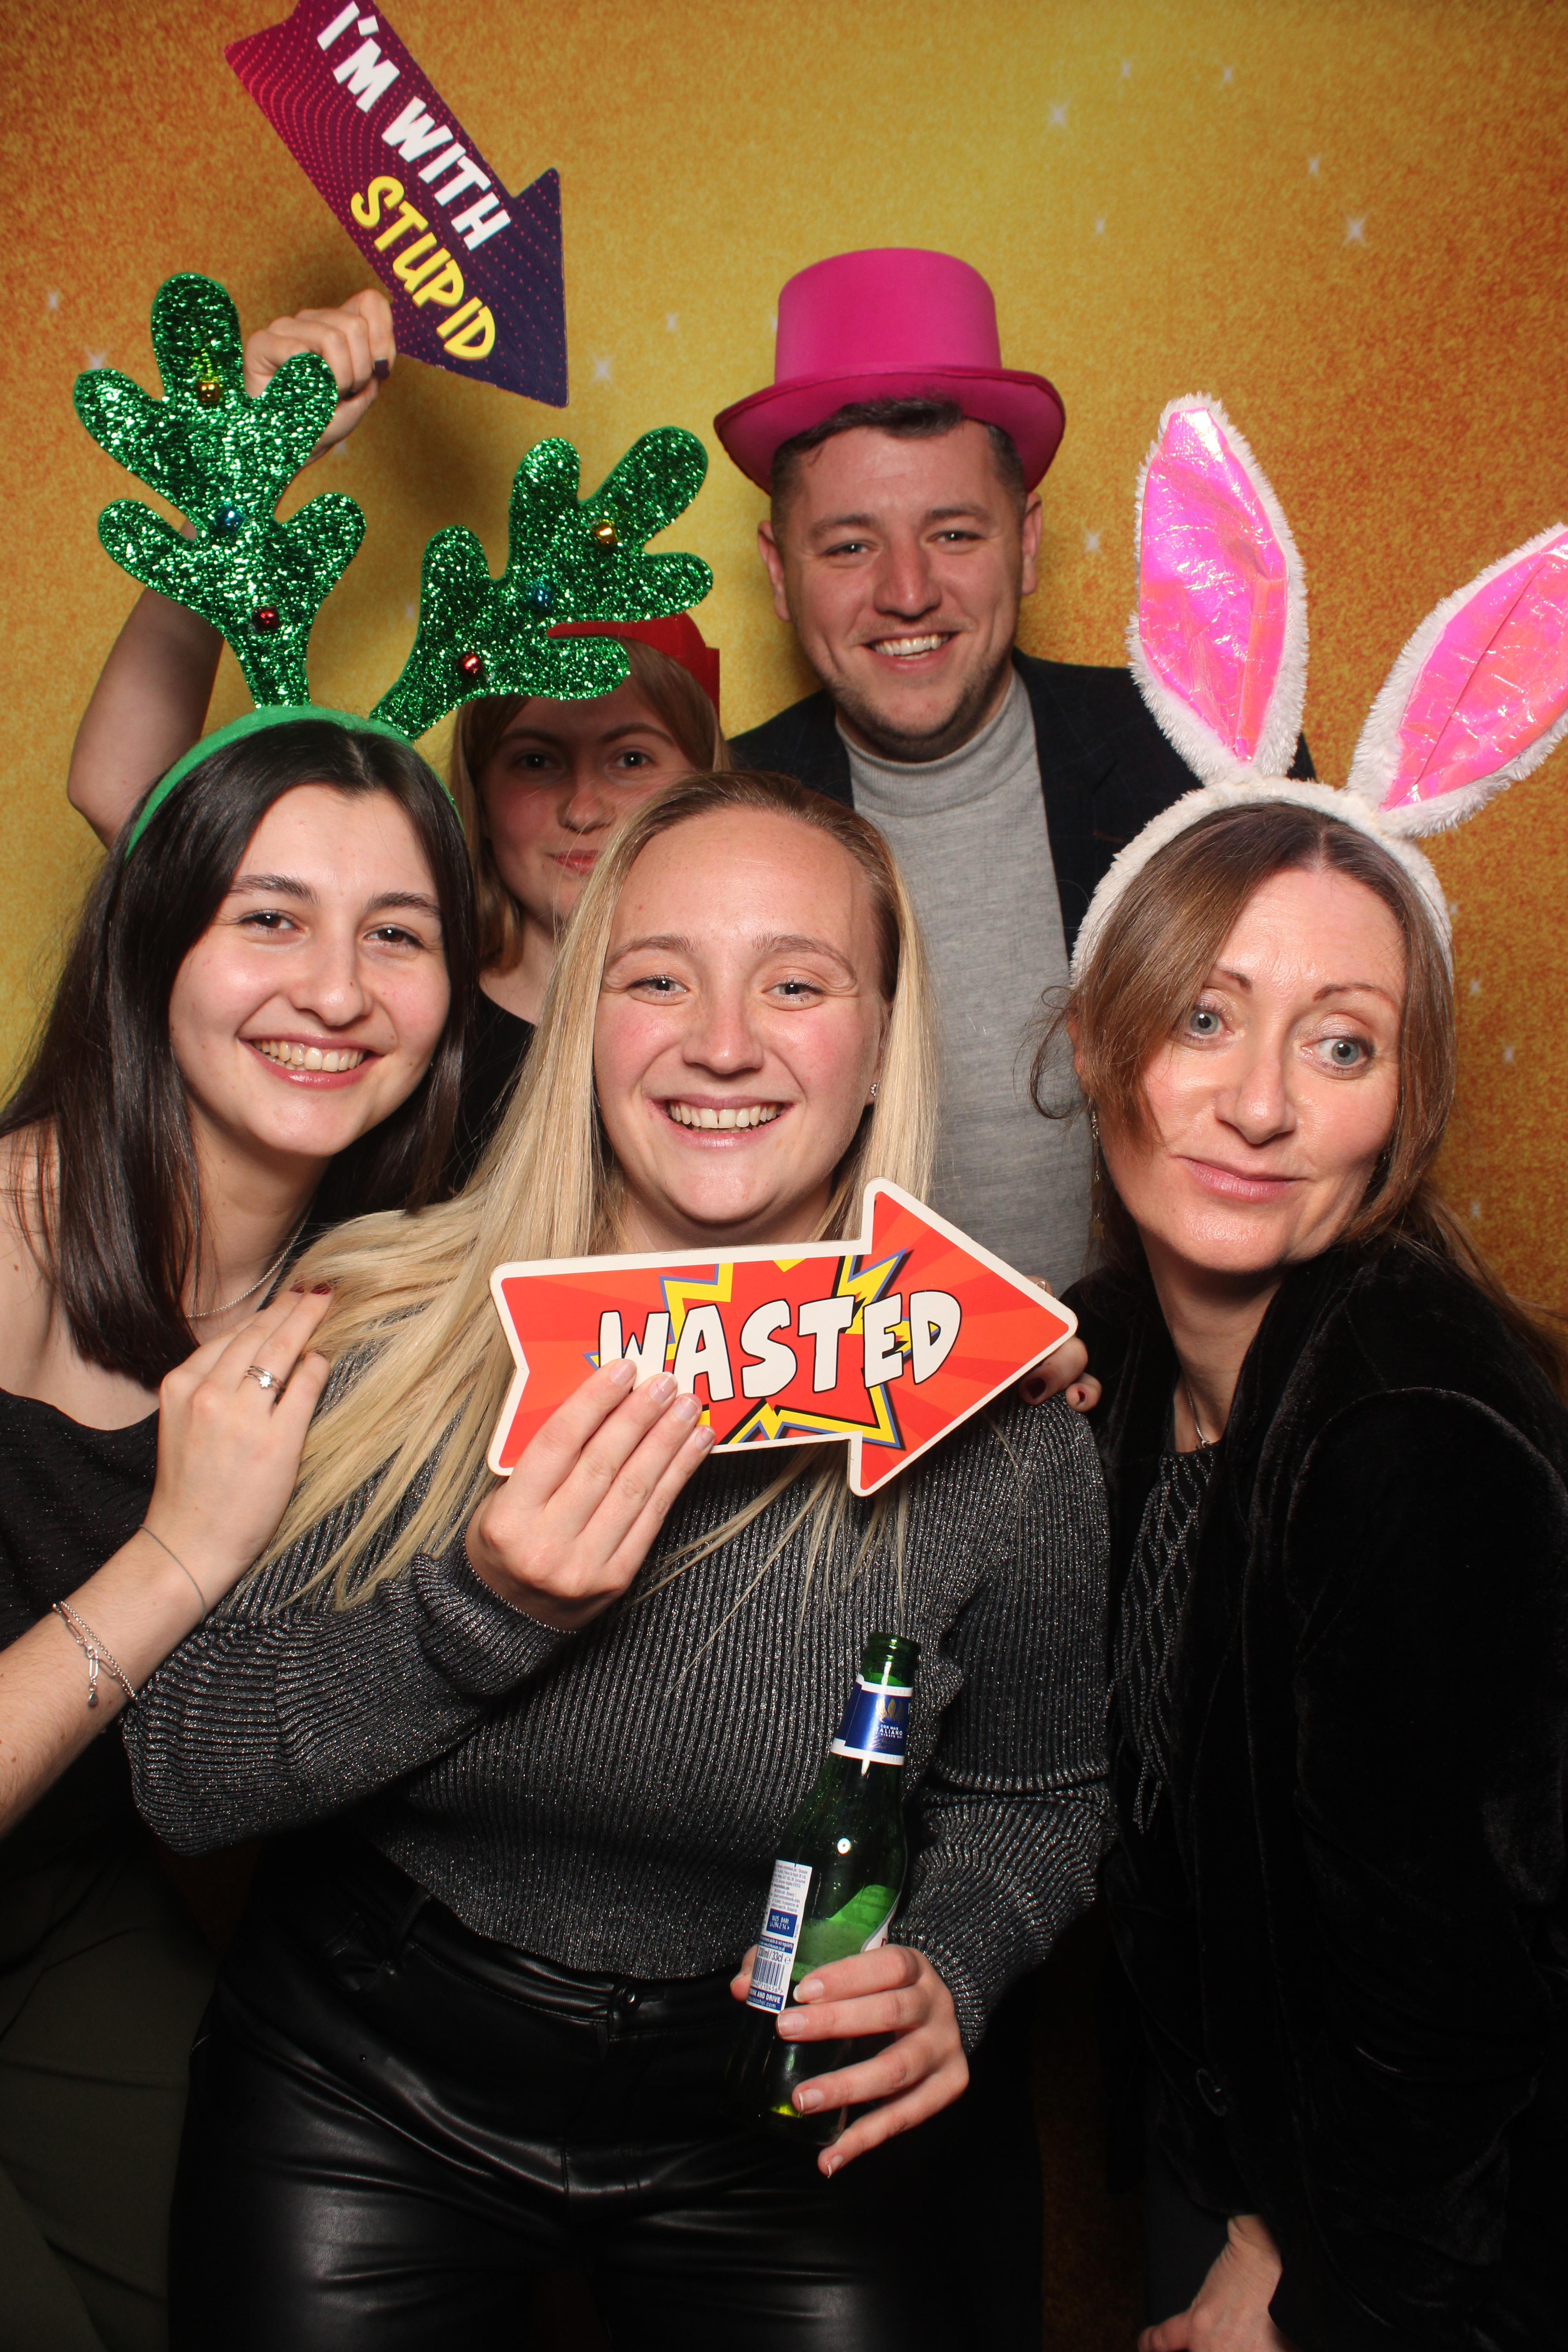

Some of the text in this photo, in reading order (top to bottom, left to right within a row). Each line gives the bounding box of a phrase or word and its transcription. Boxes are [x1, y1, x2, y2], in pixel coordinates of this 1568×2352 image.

[317, 1, 511, 250] I'M WITH
[350, 175, 496, 361] STUPID
[598, 1290, 962, 1401] WASTED
[876, 1727, 903, 1736] TALIANO
[766, 1993, 781, 2004] DRIVE
